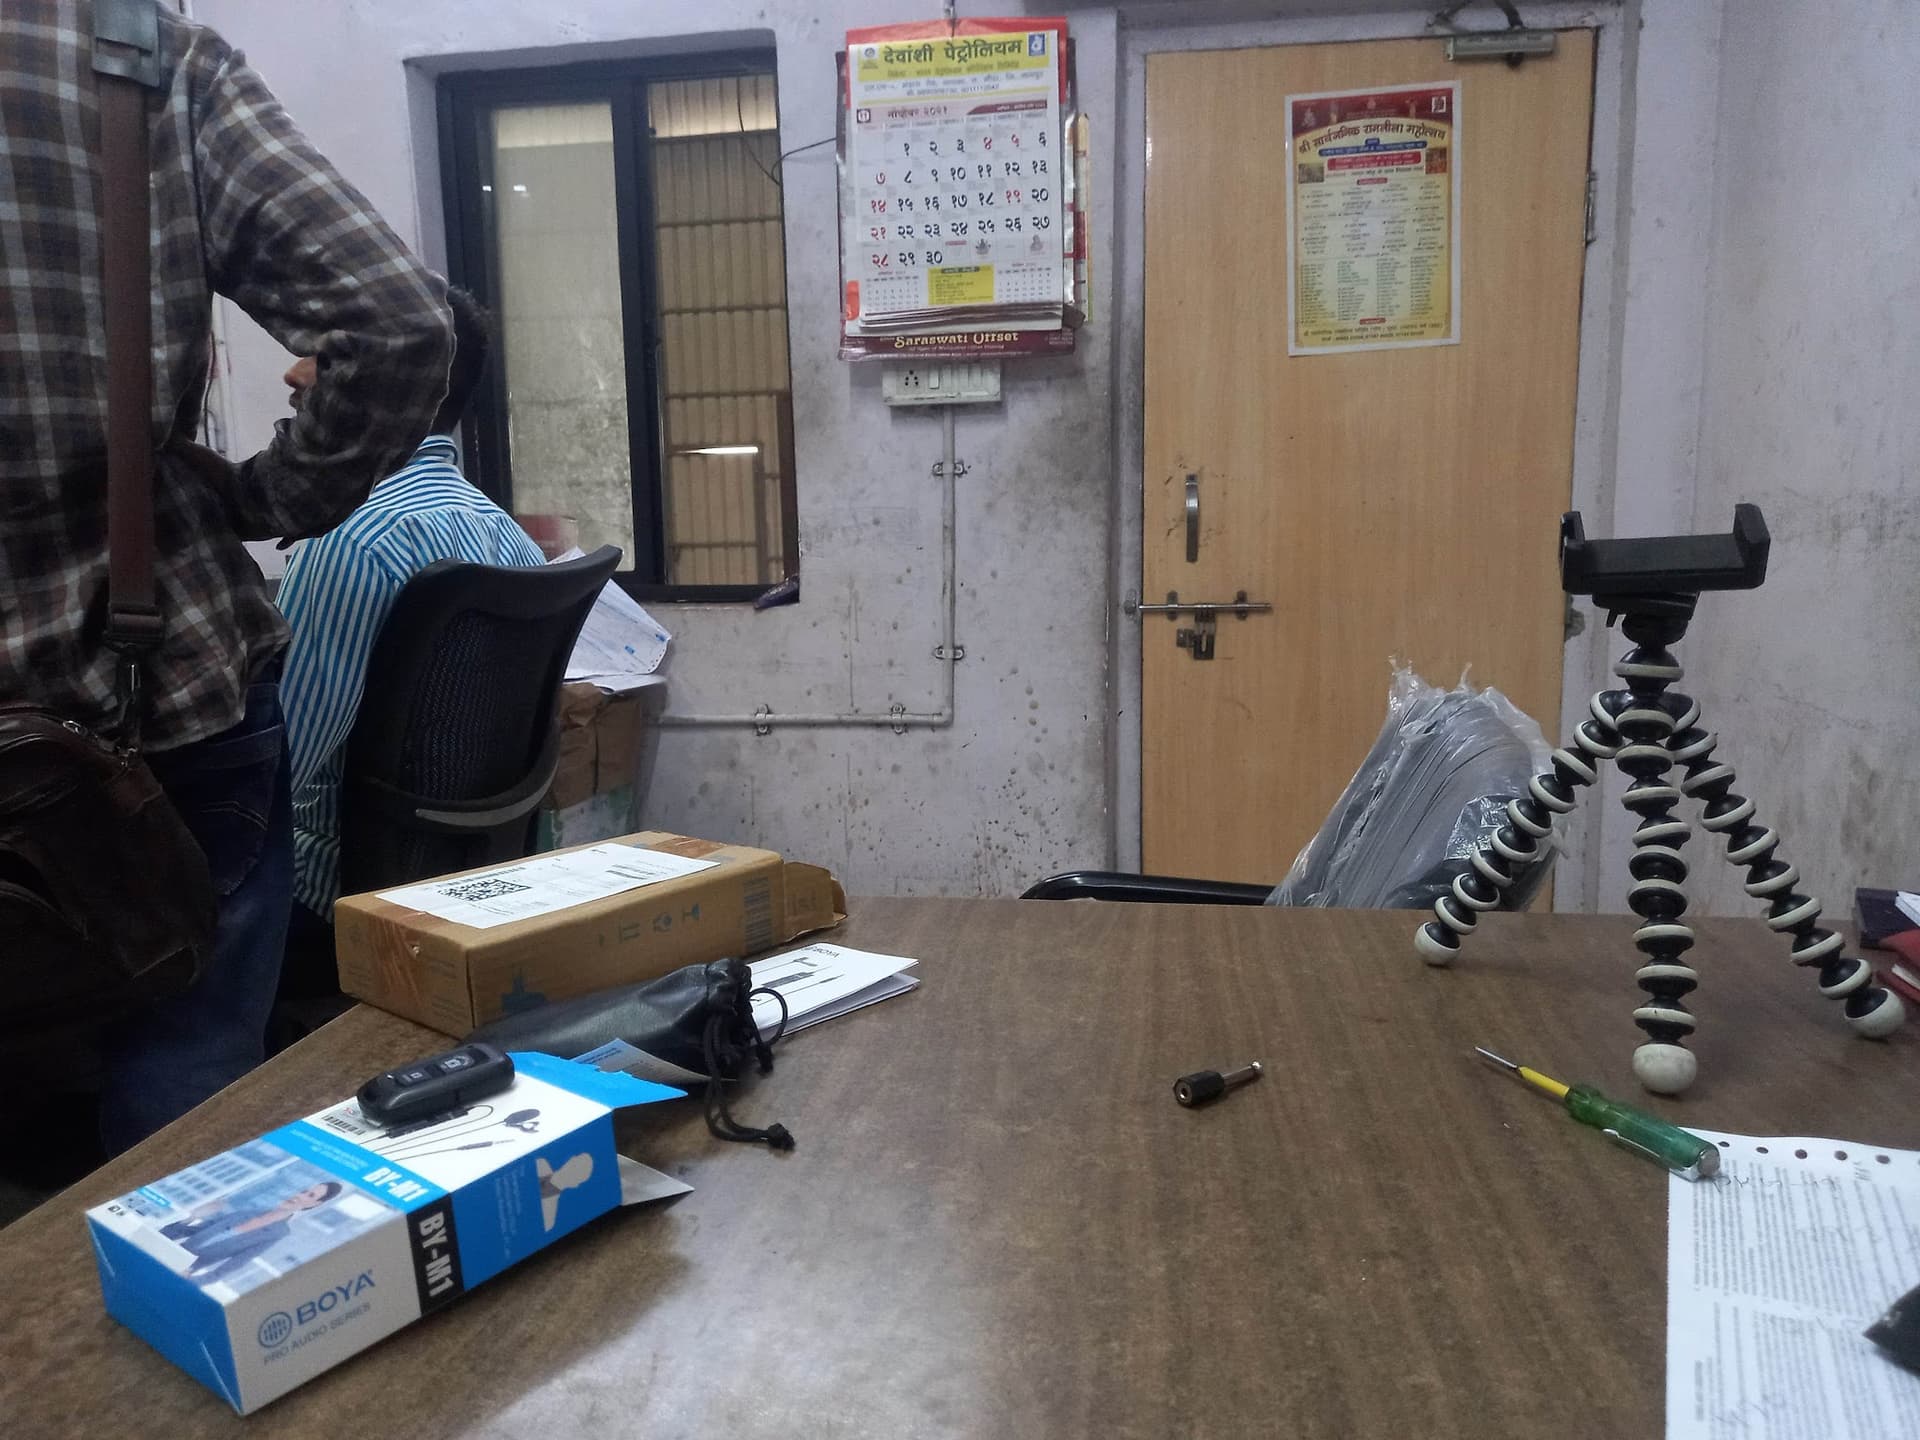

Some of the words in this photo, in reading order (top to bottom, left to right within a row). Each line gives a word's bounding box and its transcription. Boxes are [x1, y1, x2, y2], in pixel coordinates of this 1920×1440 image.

[884, 42, 934, 63] देवांशी
[944, 37, 1022, 63] पेट्रोलियम
[904, 142, 910, 156] १
[930, 141, 938, 155] २
[957, 139, 964, 152] ३
[983, 136, 992, 150] ४
[1011, 134, 1020, 147] ५
[1038, 131, 1047, 147] ६
[876, 172, 886, 185] ७
[904, 170, 912, 183] ८
[931, 168, 938, 182] ९
[950, 166, 966, 181] १०
[978, 164, 992, 178] ११
[1005, 162, 1021, 176] १२
[1032, 160, 1047, 174] १३
[871, 199, 886, 213] १४
[898, 198, 913, 212] १५
[925, 196, 940, 211] १६
[951, 194, 967, 209] १७
[979, 192, 994, 206] १८
[1006, 189, 1020, 204] १९
[1031, 188, 1049, 203] २०
[871, 226, 886, 240] २१
[898, 225, 914, 239] २२
[925, 224, 941, 238] २३
[951, 221, 968, 236] २४
[978, 219, 995, 234] २५
[1005, 217, 1022, 232] २६
[1032, 216, 1050, 231] २७
[872, 253, 889, 268] २८
[899, 252, 915, 267] २९
[926, 250, 943, 265] ३०
[894, 334, 968, 349] Saraswati
[363, 1166, 430, 1203] BY-M1
[418, 1211, 454, 1297] BY-M1
[296, 1271, 375, 1325] BOYA
[263, 1345, 290, 1365] PRO
[291, 1324, 329, 1348] AUDIO
[330, 1302, 371, 1330] SERIES
